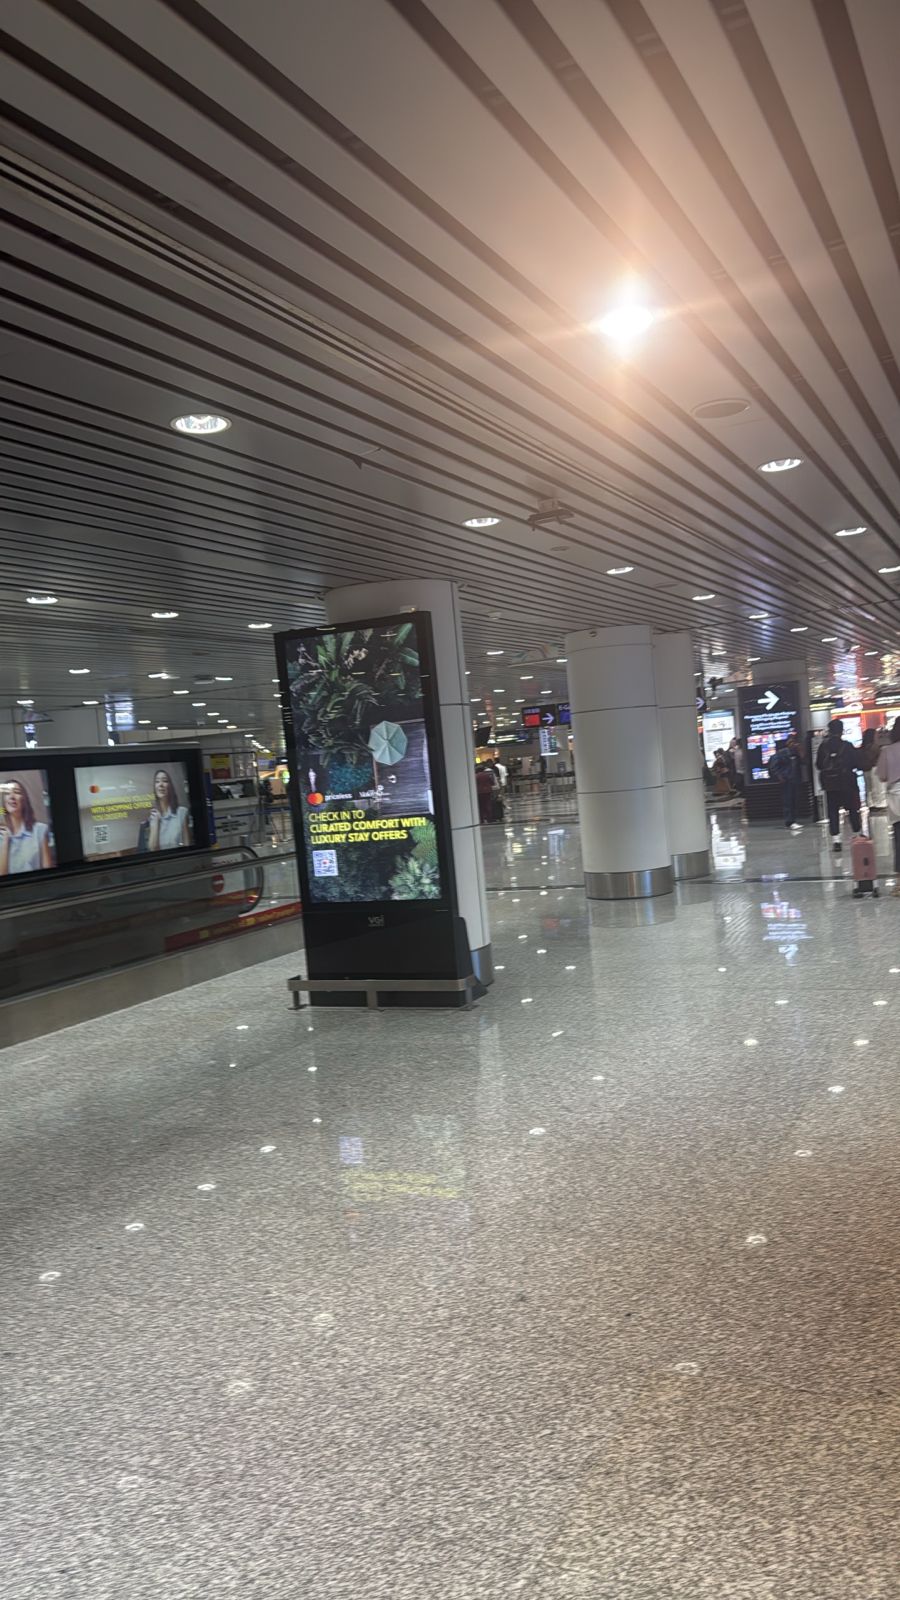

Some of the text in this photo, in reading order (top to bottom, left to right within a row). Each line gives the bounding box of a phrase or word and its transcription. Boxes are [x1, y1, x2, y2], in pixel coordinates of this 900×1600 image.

[308, 809, 365, 822] CHECK IN TO
[309, 817, 426, 833] CURATED COMFORT WITH
[310, 829, 408, 844] LUXURY STAY OFFERS
